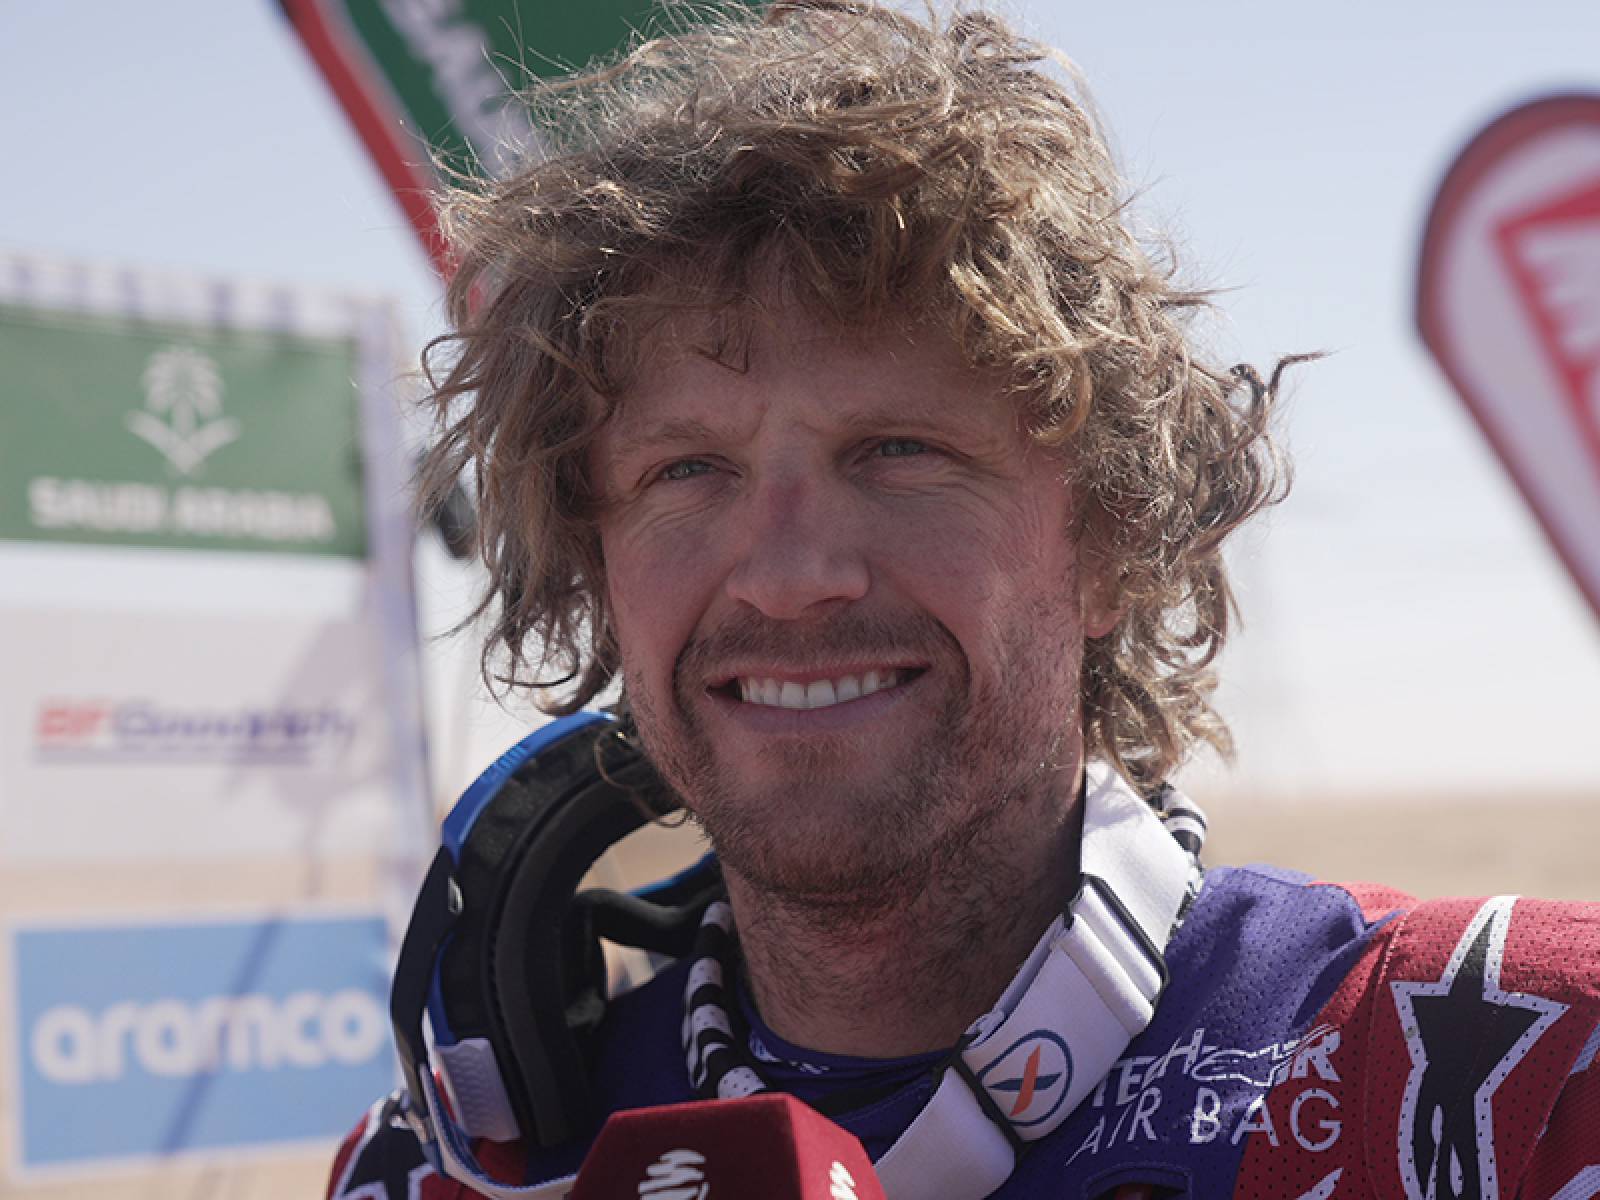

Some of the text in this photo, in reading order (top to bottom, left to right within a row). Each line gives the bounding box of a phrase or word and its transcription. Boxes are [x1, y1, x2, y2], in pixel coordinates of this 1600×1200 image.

[30, 479, 335, 542] SAUDI ARABIA
[33, 988, 384, 1083] aramco
[1189, 1087, 1342, 1152] BAG
